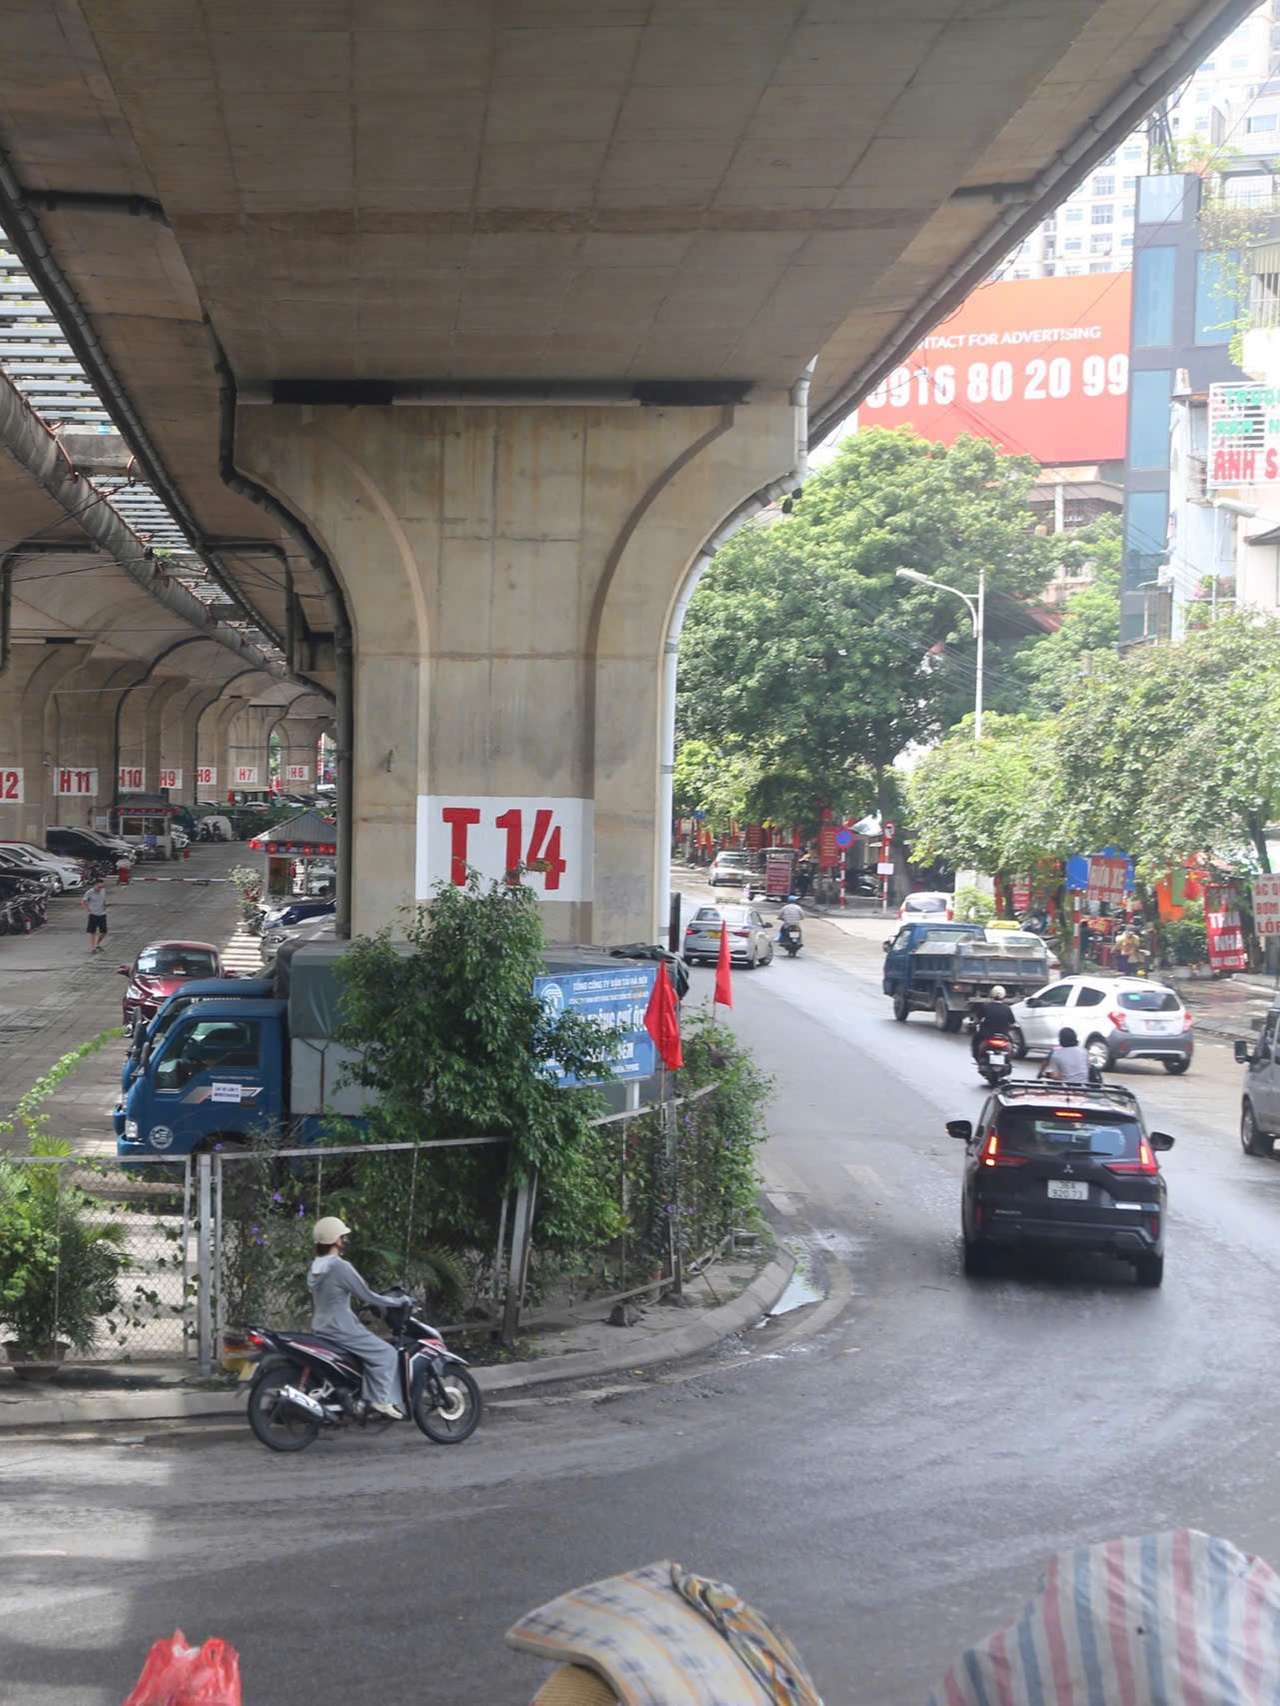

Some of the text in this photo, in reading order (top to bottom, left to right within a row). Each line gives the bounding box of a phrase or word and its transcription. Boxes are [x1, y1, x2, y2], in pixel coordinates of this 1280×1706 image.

[969, 331, 999, 346] FOR
[1000, 325, 1102, 346] ADVERTISING
[967, 361, 1012, 403] 80
[1024, 357, 1070, 399] 20
[1082, 353, 1129, 396] 99
[1265, 448, 1280, 479] S
[442, 807, 566, 890] T 14
